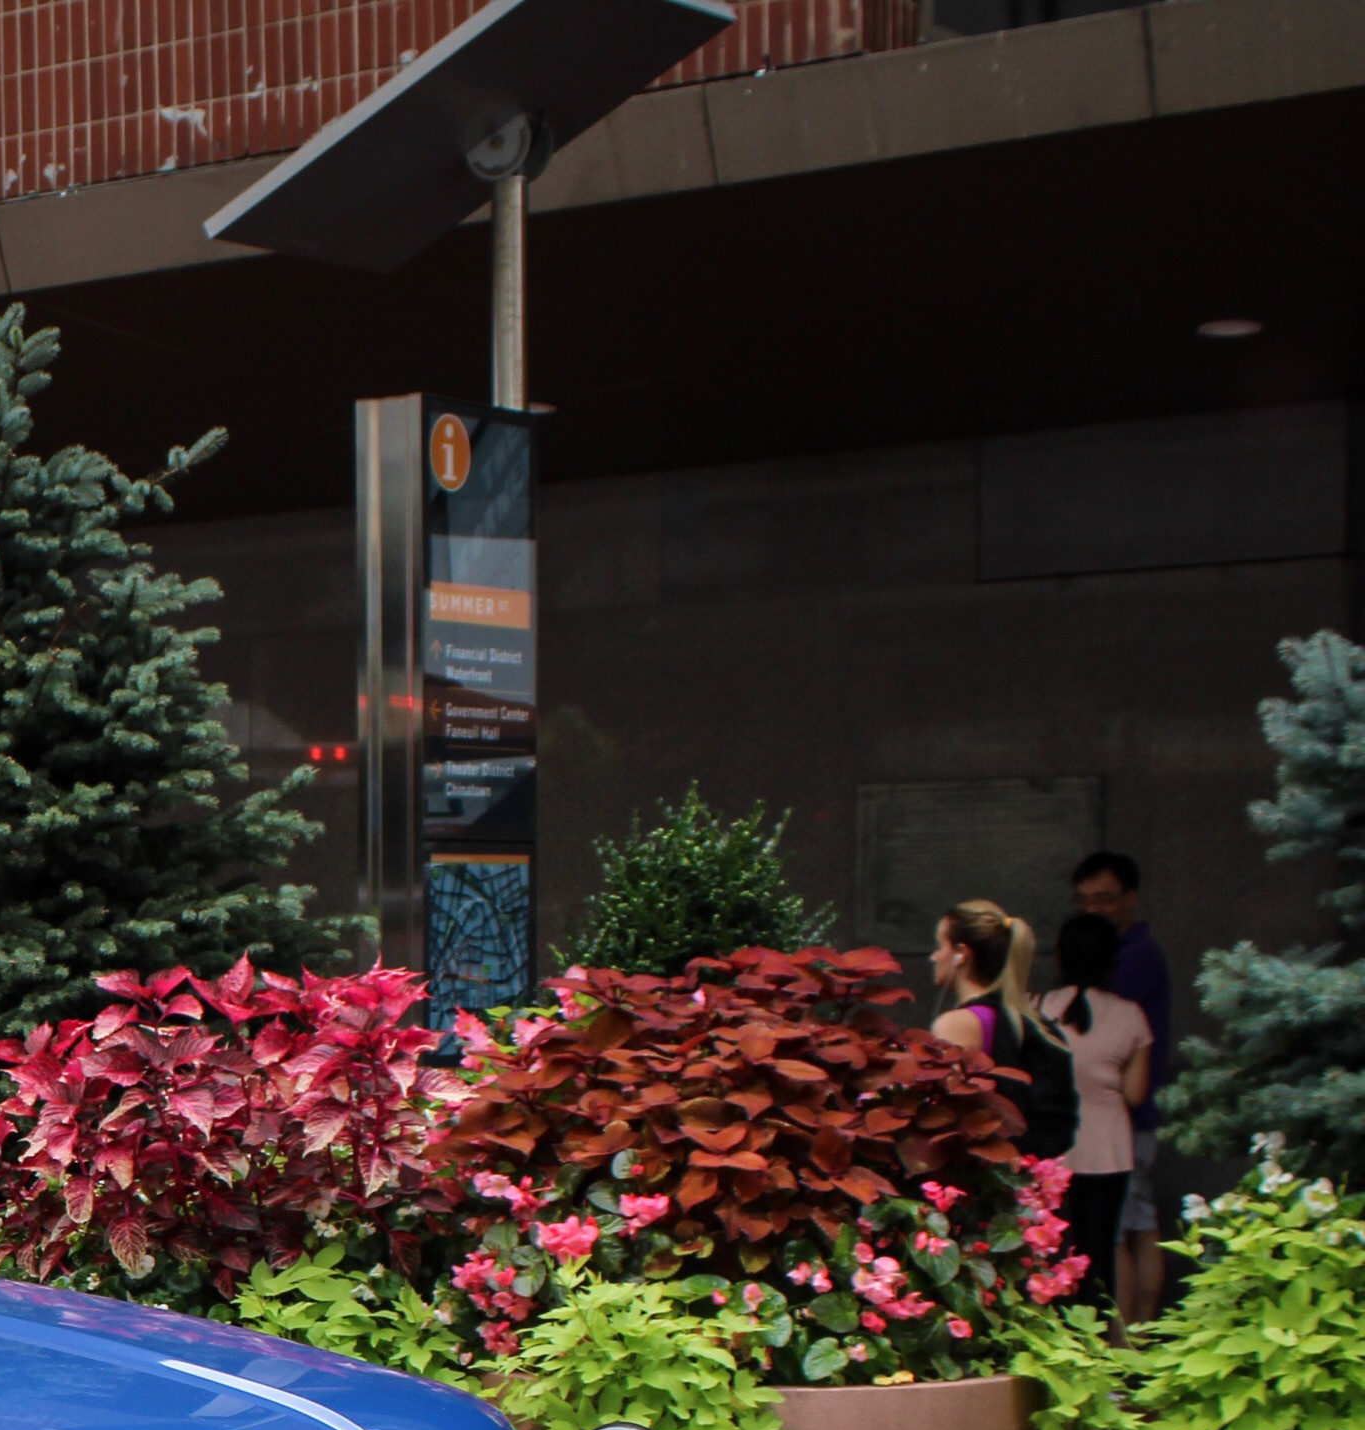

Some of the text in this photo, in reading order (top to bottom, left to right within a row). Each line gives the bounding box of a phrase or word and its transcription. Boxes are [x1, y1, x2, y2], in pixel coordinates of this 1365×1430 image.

[430, 592, 494, 615] SUMMER
[446, 643, 522, 663] Financial District
[446, 665, 492, 682] Waterfront
[446, 702, 529, 722] Government Center
[445, 723, 500, 740] Faneuil Hall
[446, 760, 514, 778] Theater District
[446, 782, 492, 797] Chinatown
